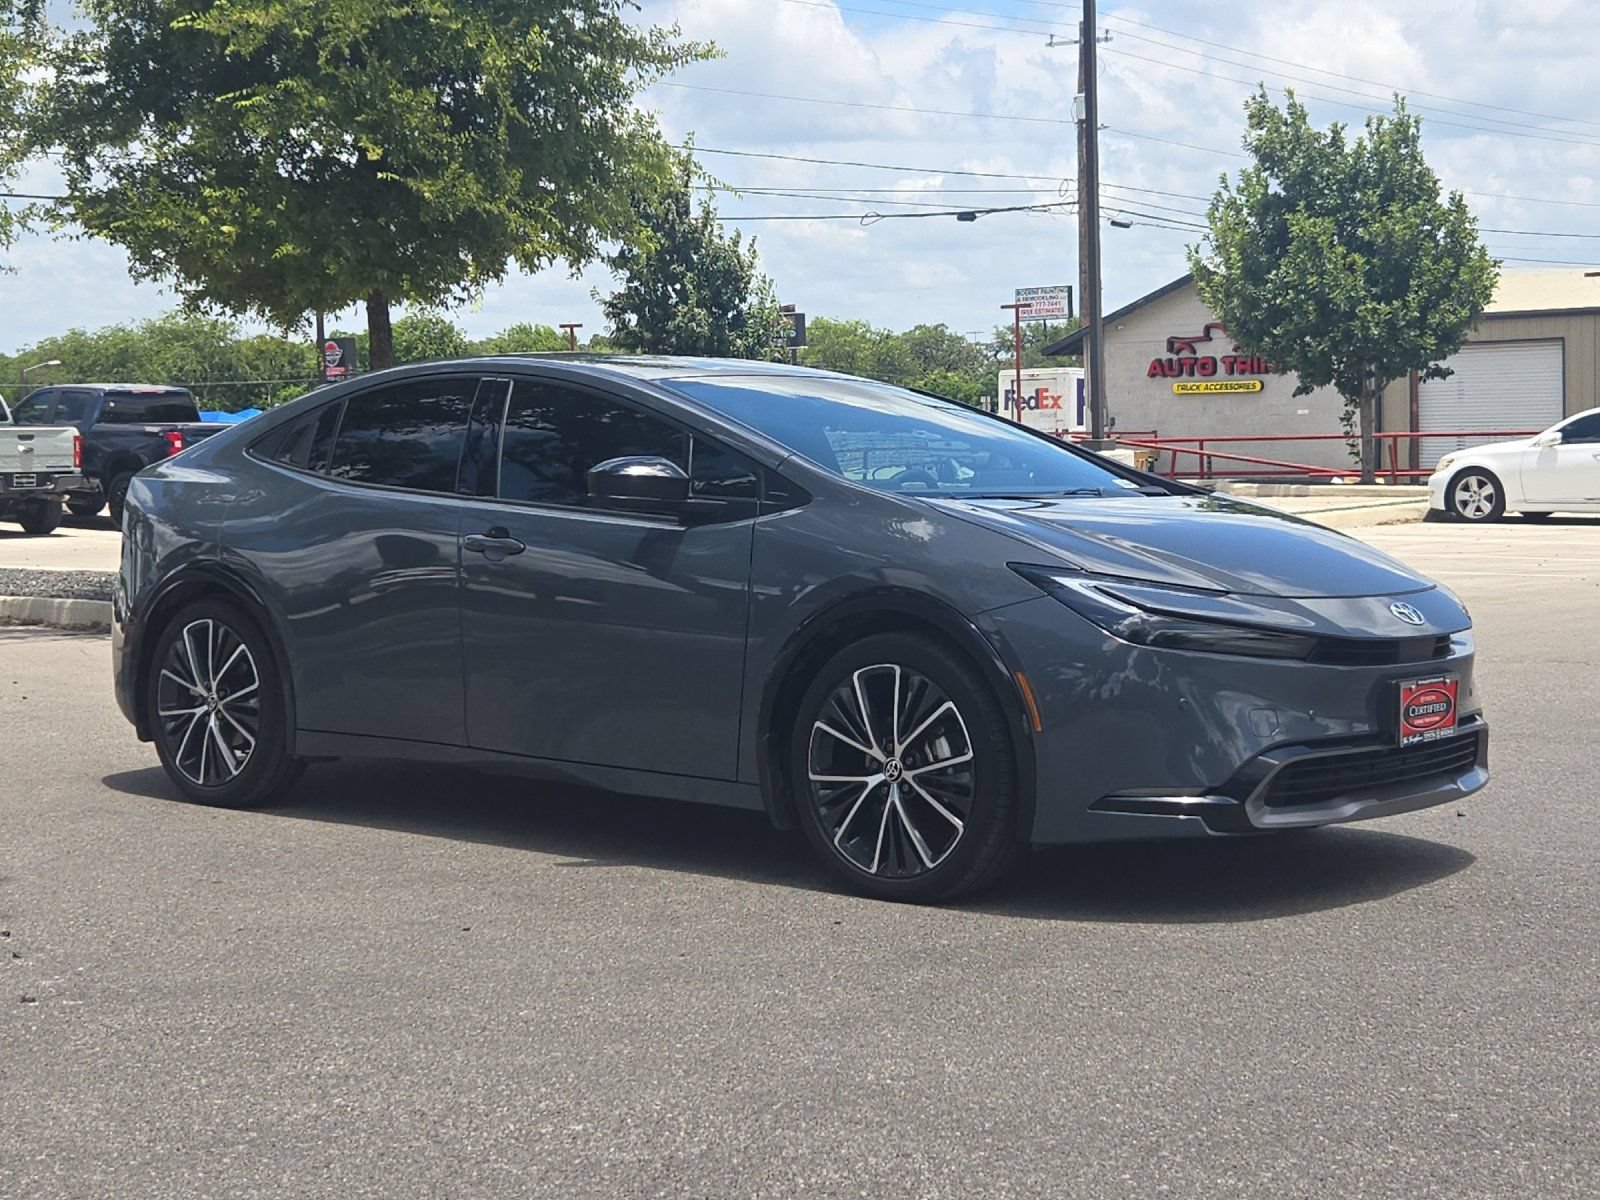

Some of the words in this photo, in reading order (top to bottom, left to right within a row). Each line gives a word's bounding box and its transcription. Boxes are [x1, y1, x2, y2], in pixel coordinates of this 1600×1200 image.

[1035, 307, 1064, 315] ESTIMATES
[1147, 356, 1217, 378] AUTO
[1176, 383, 1202, 392] TRUCK
[1203, 382, 1257, 391] ACCESSORIES
[1004, 387, 1063, 411] FedEx
[1409, 703, 1446, 716] CERTIFIED
